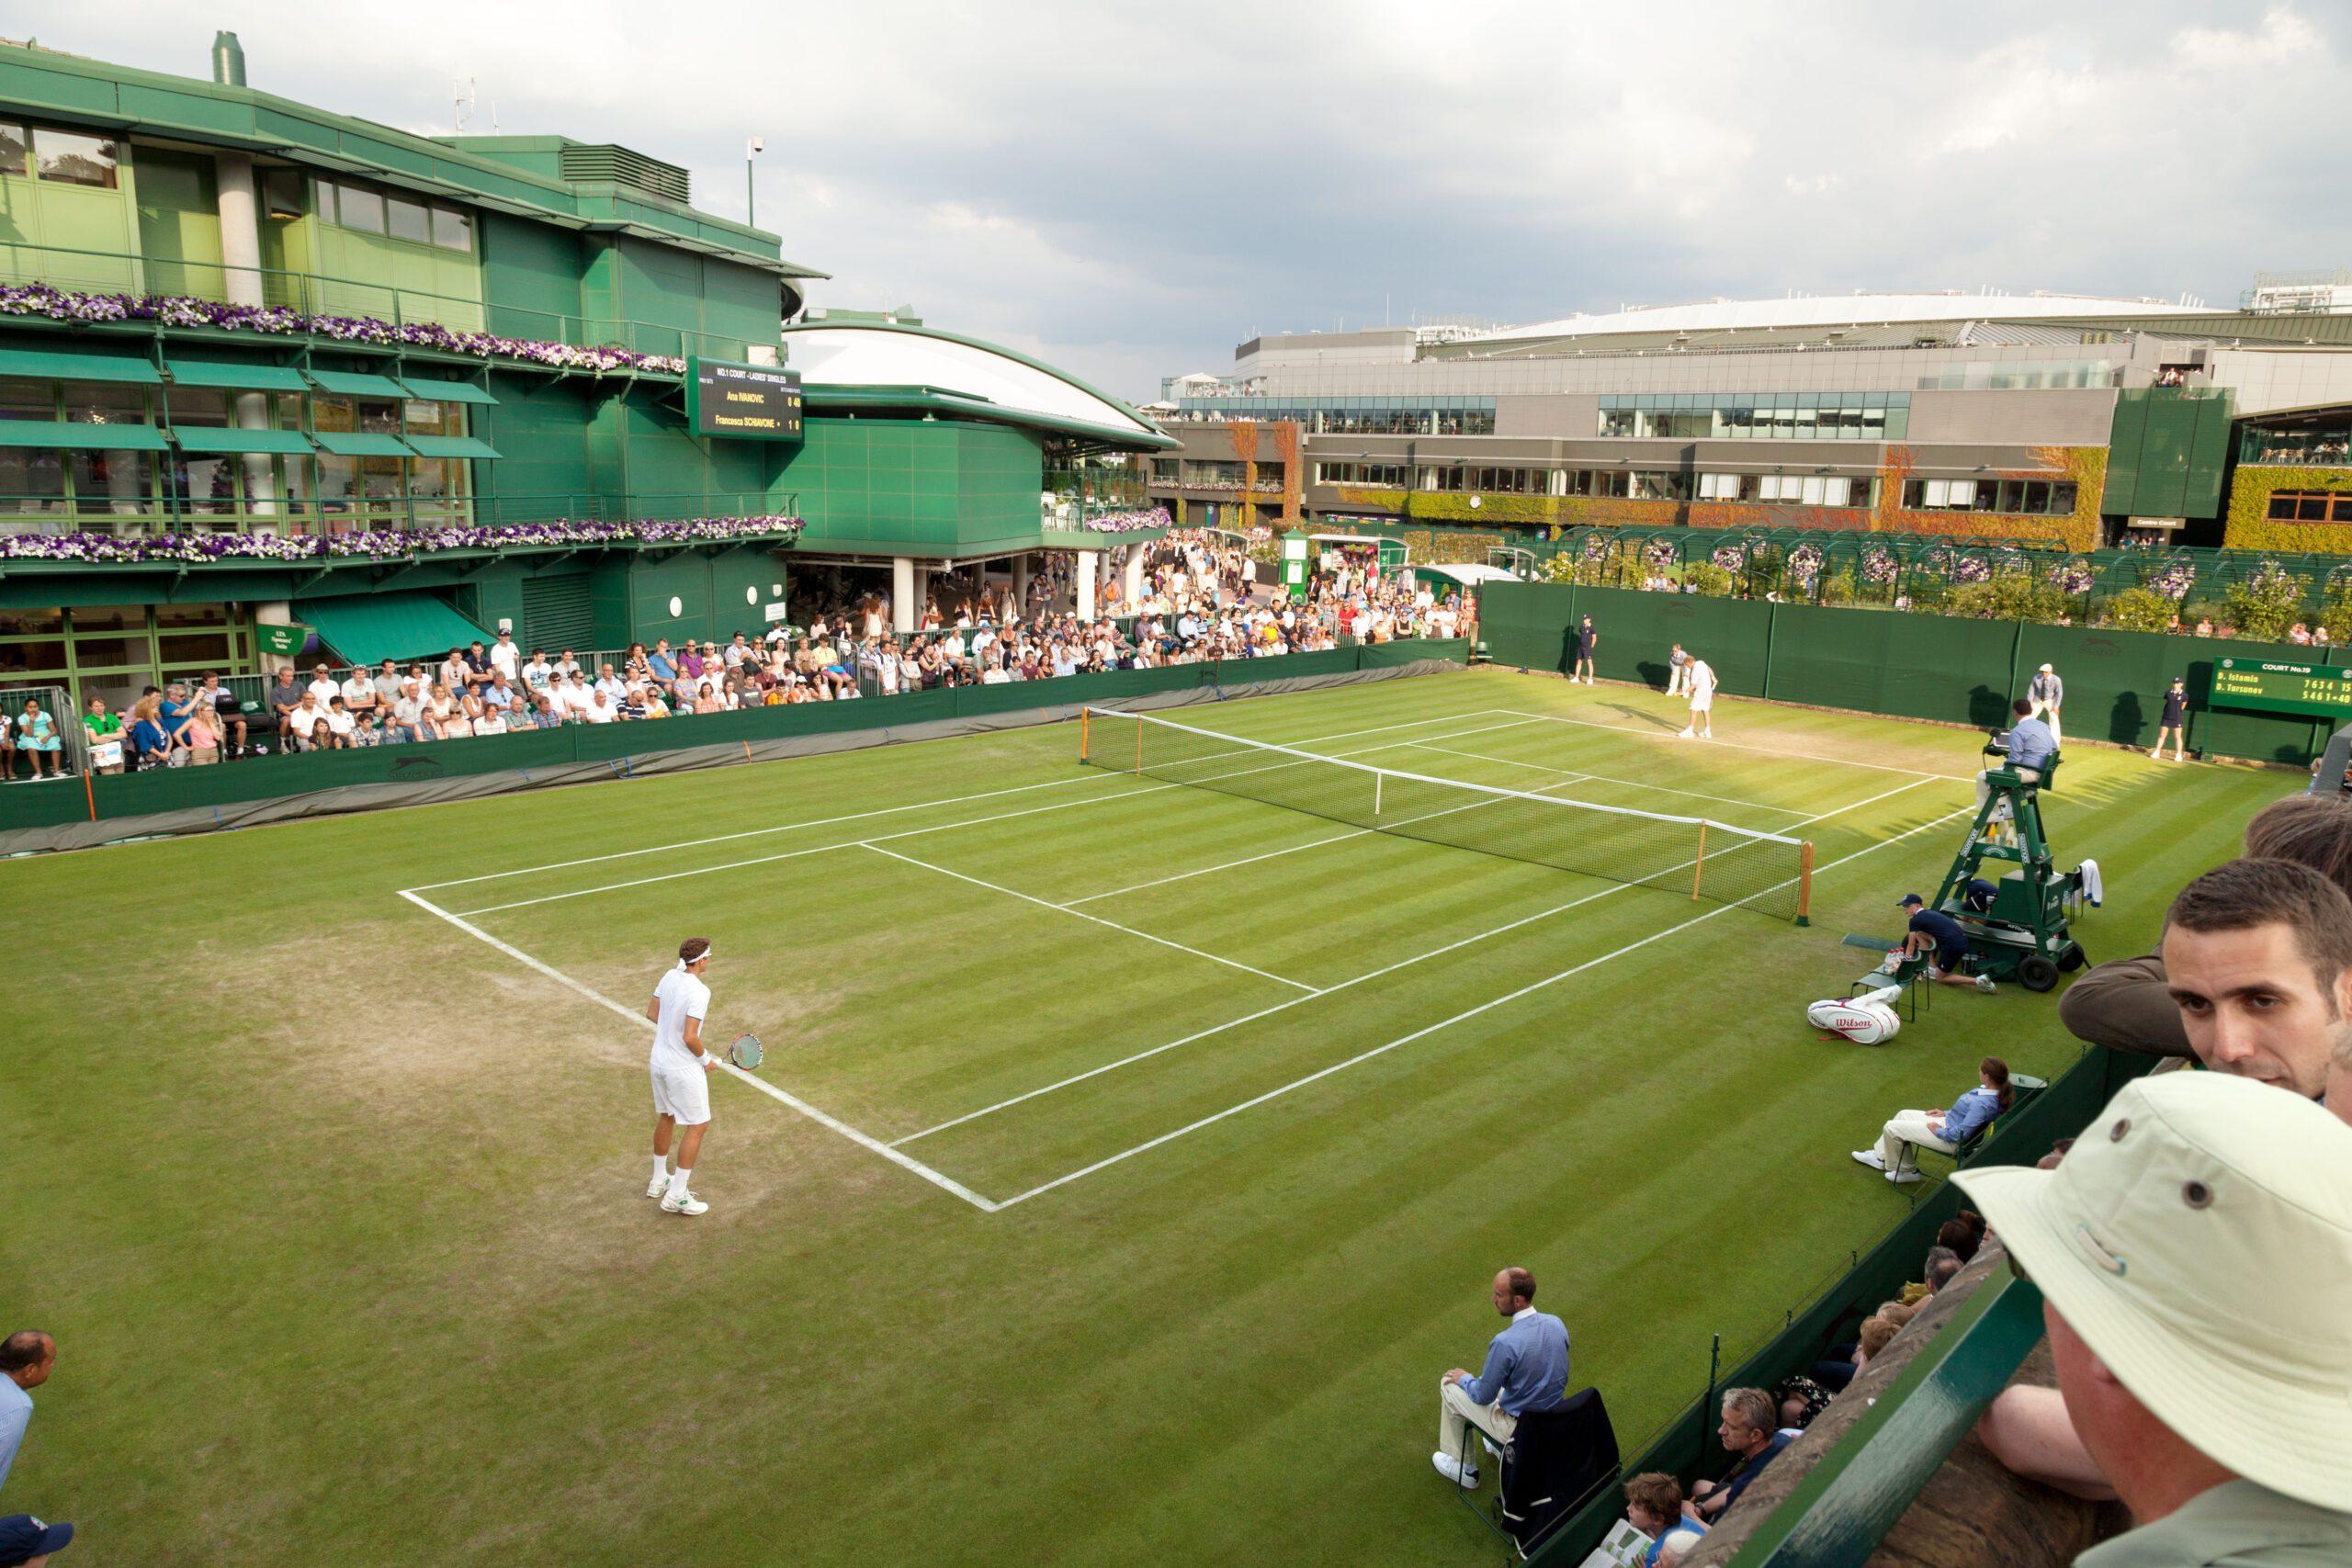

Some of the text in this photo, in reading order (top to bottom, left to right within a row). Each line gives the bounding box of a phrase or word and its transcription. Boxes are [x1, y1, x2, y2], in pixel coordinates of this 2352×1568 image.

[729, 369, 746, 378] COURT
[767, 374, 786, 384] SINGLES
[727, 391, 738, 401] Ana
[739, 392, 764, 403] IVANOVIC
[715, 415, 743, 426] Francesca
[744, 417, 775, 428] SCHIAVONE
[2262, 663, 2289, 671] COURT
[1836, 1018, 1871, 1028] Wilson
